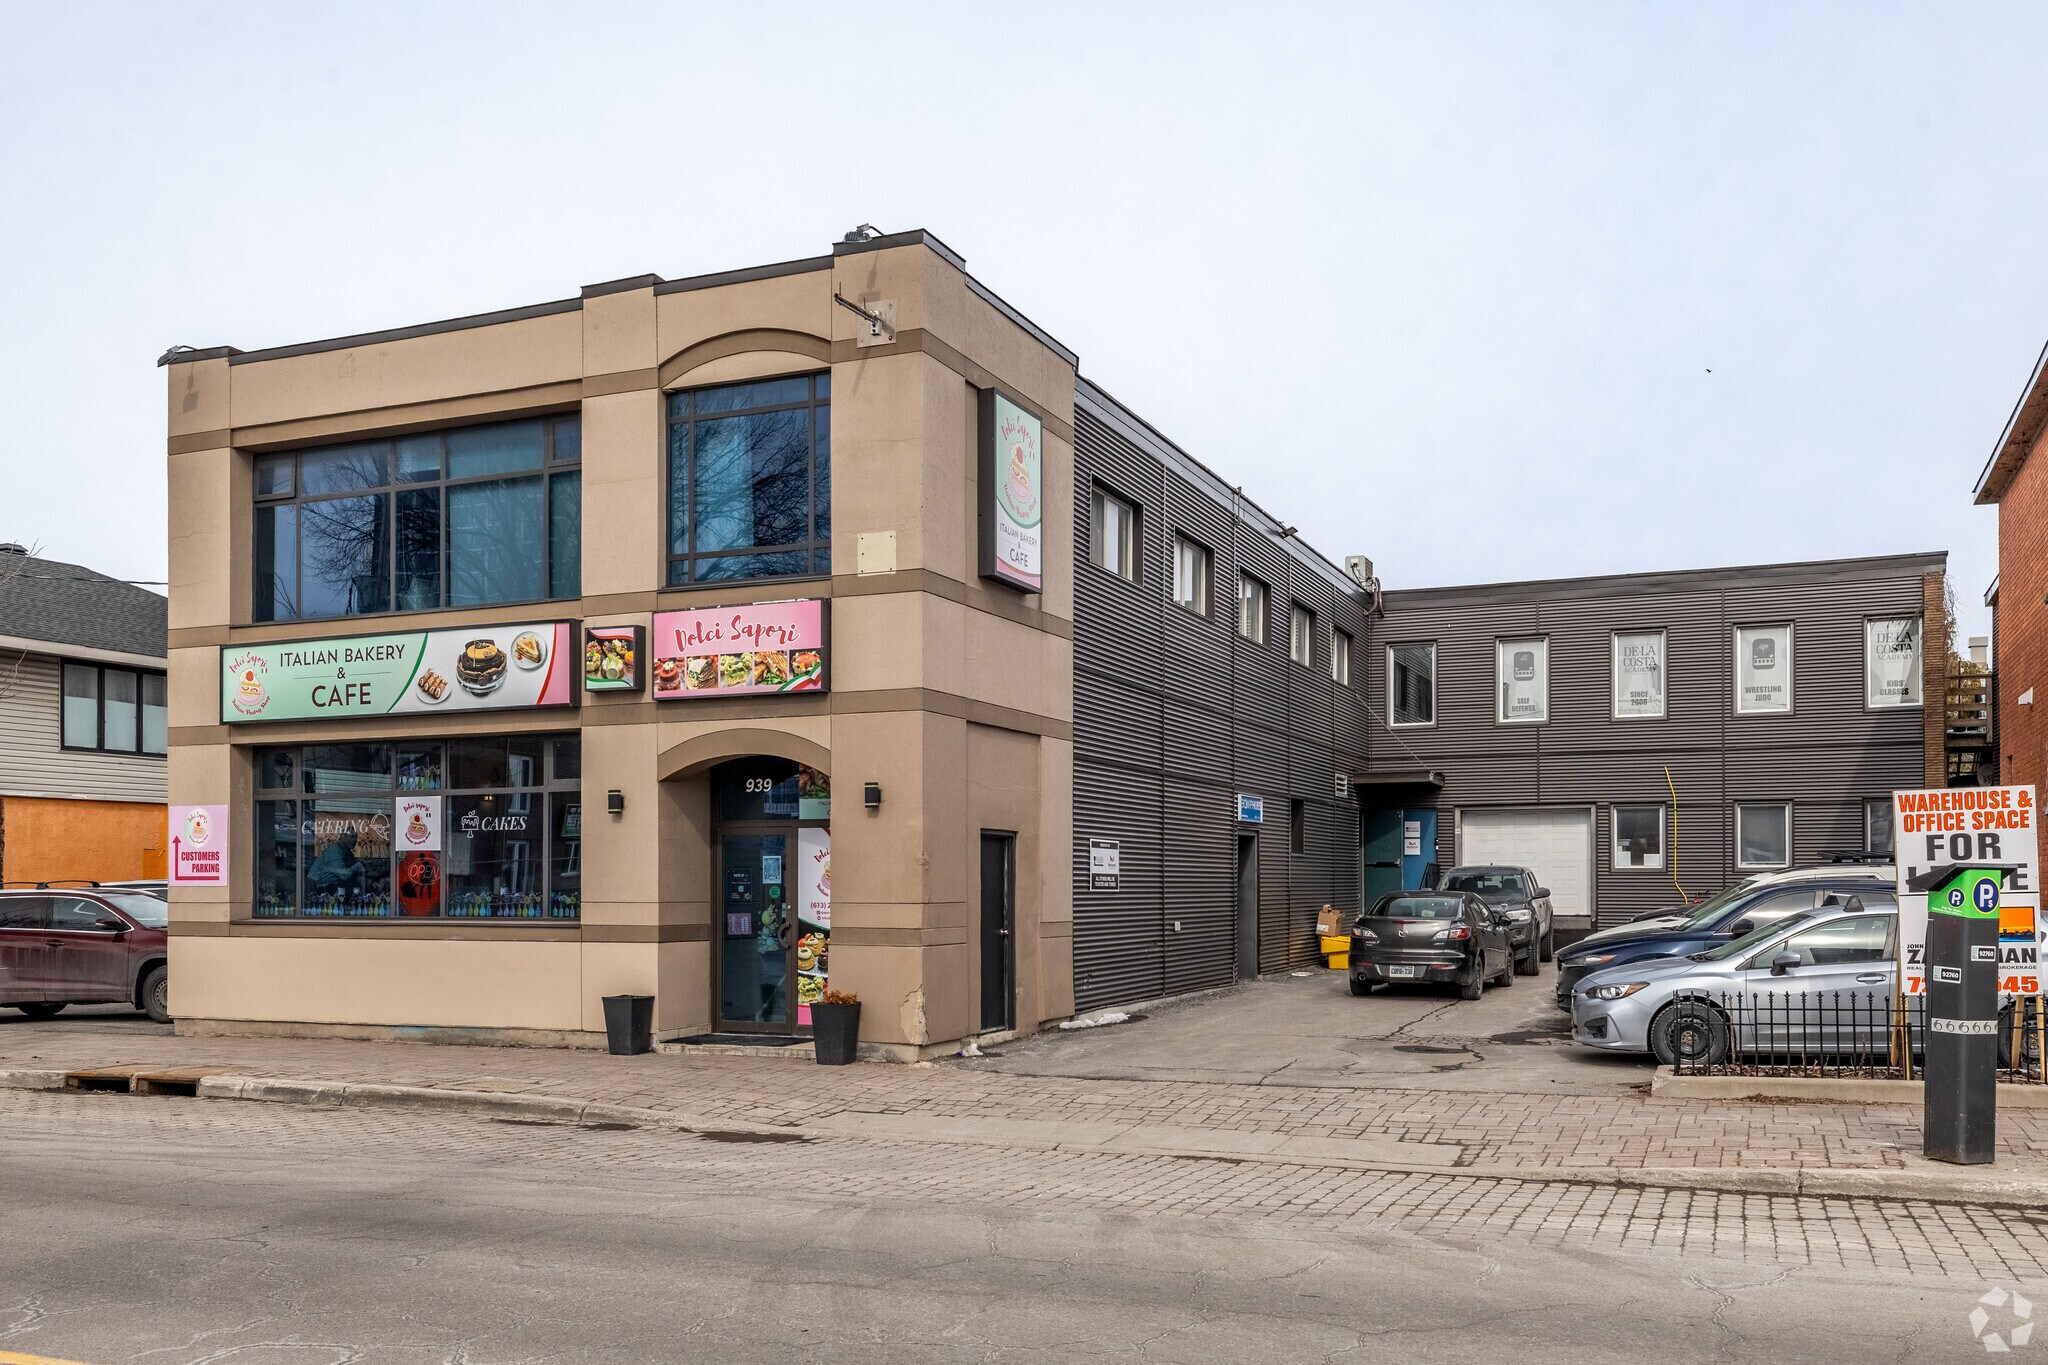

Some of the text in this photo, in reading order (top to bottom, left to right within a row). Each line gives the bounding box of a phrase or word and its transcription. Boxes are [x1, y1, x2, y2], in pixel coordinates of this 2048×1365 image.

[1000, 521, 1038, 547] ITALIAN BAKERY
[1010, 548, 1028, 567] CAFE
[674, 613, 799, 652] Dolci Sapori
[280, 644, 405, 667] ITALIAN BAKERY
[1876, 643, 1914, 654] COSTA
[229, 651, 268, 673] Dolci Sapori
[1623, 656, 1657, 668] COSTA
[337, 667, 346, 679] &
[311, 682, 371, 707] CAFE
[1630, 690, 1649, 698] SINCE
[1744, 685, 1782, 694] WRESTLING
[1879, 687, 1909, 696] CLASSES
[1755, 693, 1772, 702] JUDO
[1511, 704, 1536, 712] DEFENSE
[745, 779, 772, 793] 939
[1898, 790, 2033, 813] WAREHOUSE &
[301, 819, 369, 834] CATERING
[481, 815, 527, 831] CAKES
[1903, 809, 2030, 833] OFFICE SPACE
[1926, 832, 2002, 862] FOR
[181, 851, 220, 861] CUSTOMERS
[191, 863, 220, 873] PARKING
[409, 864, 440, 878] OPEN
[810, 901, 826, 910] (613)
[1941, 970, 1959, 979] 92760
